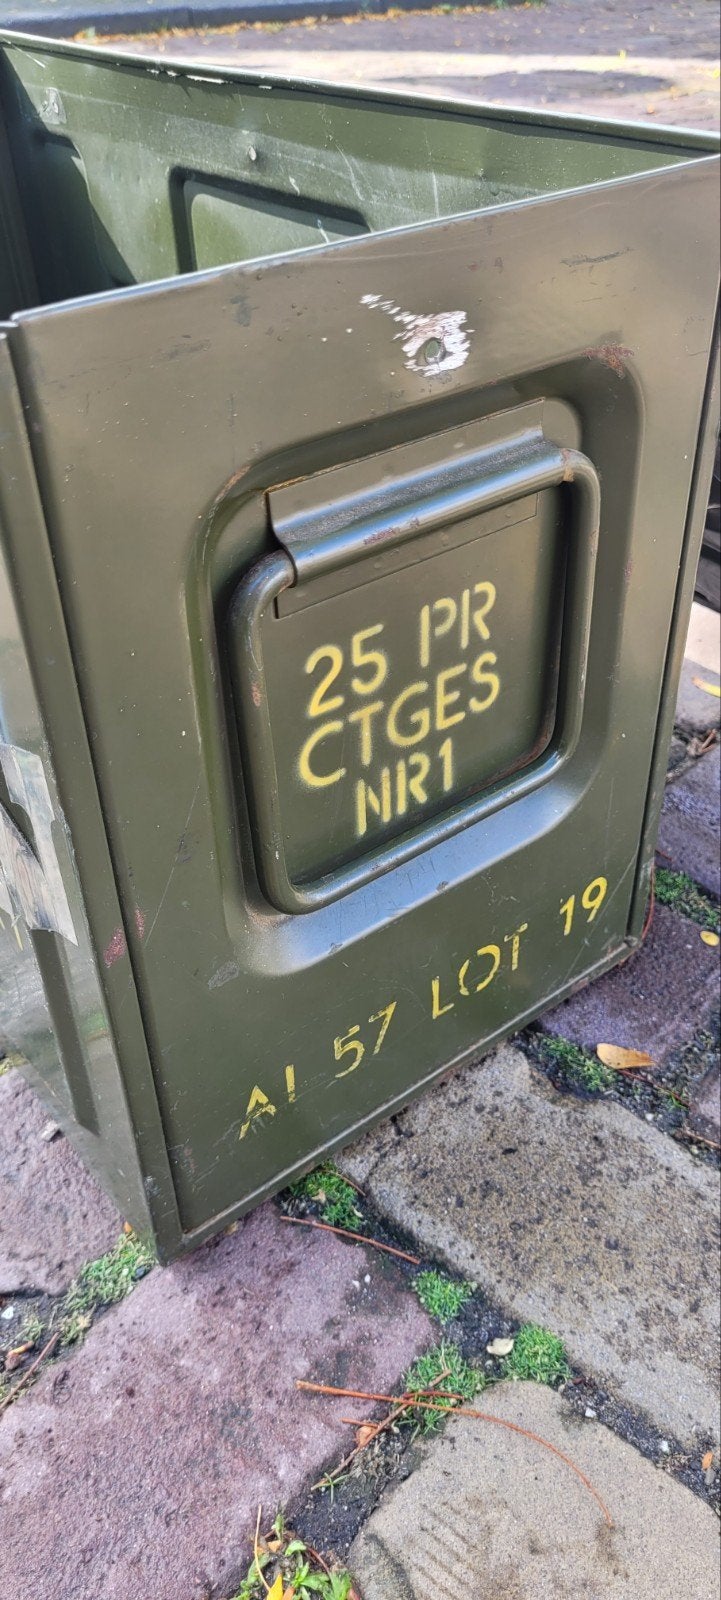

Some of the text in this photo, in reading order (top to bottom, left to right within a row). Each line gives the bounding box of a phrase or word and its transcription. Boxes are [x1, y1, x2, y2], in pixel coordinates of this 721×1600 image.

[305, 581, 496, 717] 25 PR
[298, 652, 500, 788] CTGES
[333, 1001, 397, 1078] 57
[431, 922, 528, 1019] LOT
[559, 876, 608, 936] 19
